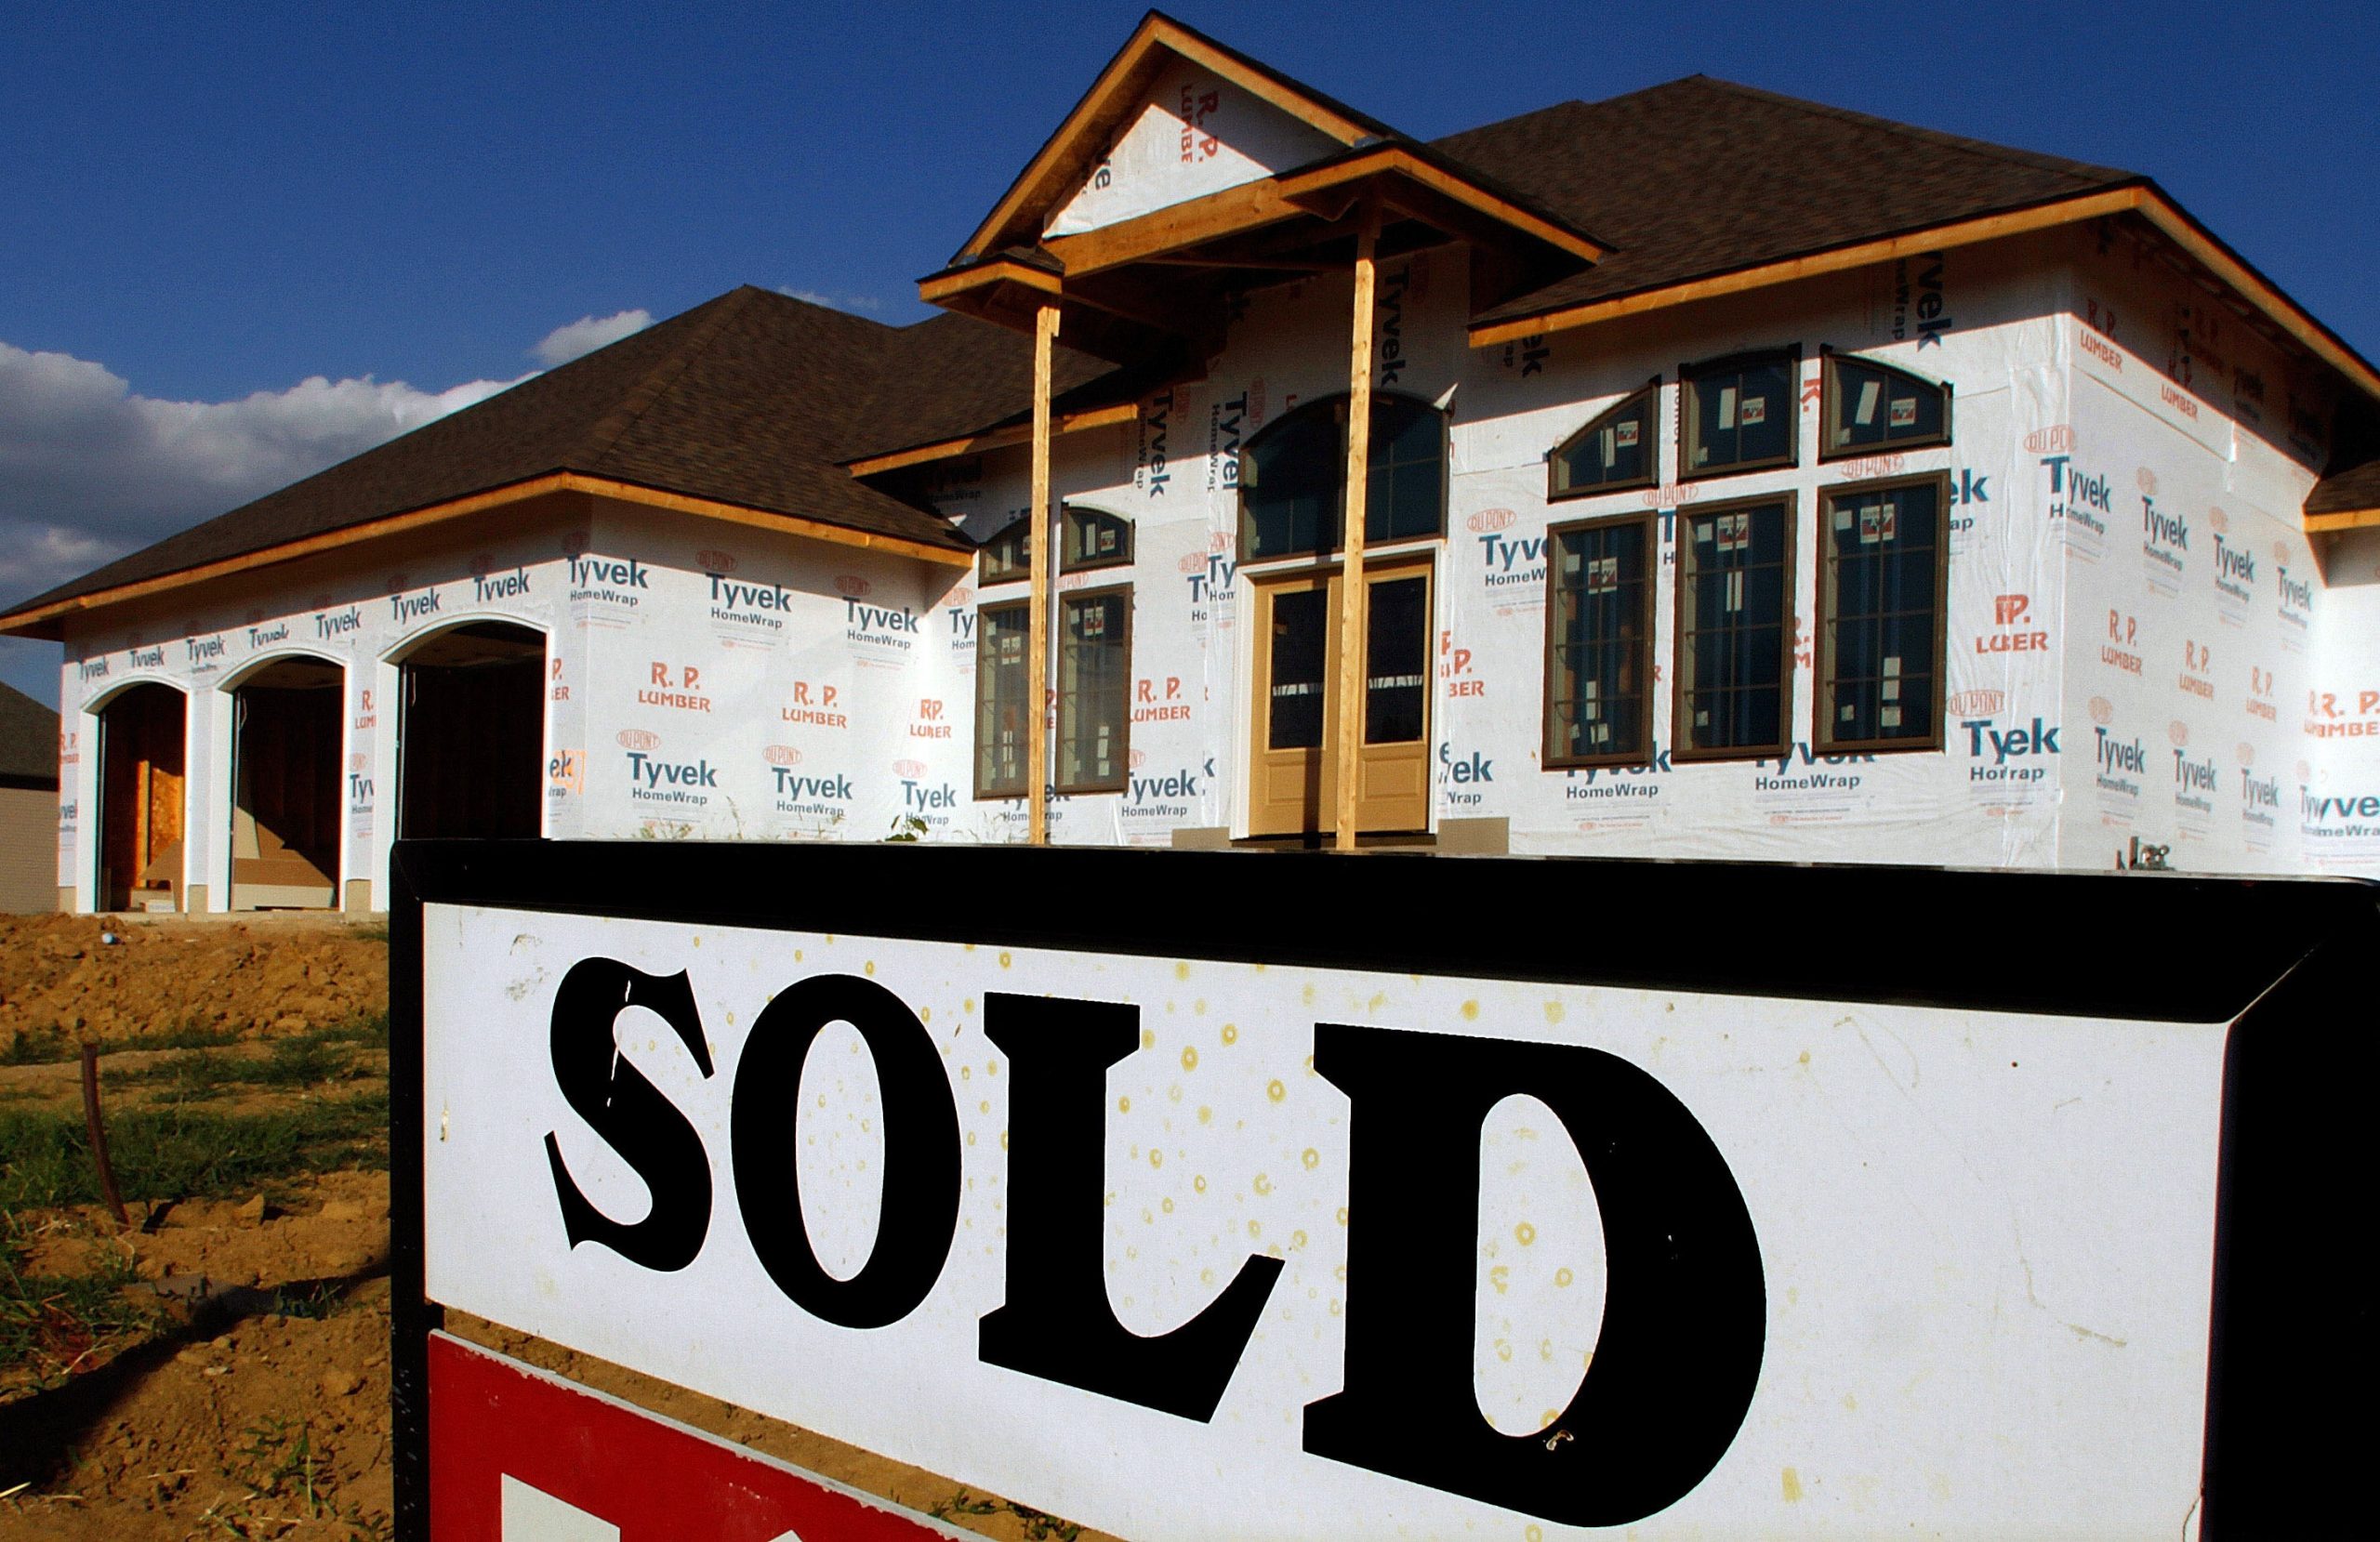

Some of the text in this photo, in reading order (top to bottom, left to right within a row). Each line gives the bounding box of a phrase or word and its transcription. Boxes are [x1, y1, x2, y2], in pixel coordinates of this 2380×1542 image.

[1917, 252, 1951, 352] vek
[1148, 389, 1173, 499] Tyvek
[2041, 455, 2110, 512] Tyvek
[2142, 495, 2187, 551] Tyvek
[1479, 534, 1547, 572] Tyv
[2214, 534, 2254, 583] Tyvek
[567, 556, 649, 589] Tyvek
[1485, 567, 1546, 586] HomeW
[570, 588, 639, 607] HomeWrap
[706, 573, 792, 613] Tyvek
[2278, 566, 2311, 613] Tyvek
[390, 587, 441, 625] Tyvek
[711, 606, 783, 630] HomeWrap
[842, 596, 919, 634] Tyvek
[316, 606, 361, 639] Tyvek
[186, 636, 226, 661] Tyvek
[847, 629, 911, 651] HomeWrap
[651, 662, 700, 691] R. P.
[2101, 646, 2142, 677] LUMBER
[639, 690, 710, 713] LUMBER
[794, 681, 838, 707] R. P.
[1138, 677, 1182, 703] R. P.
[2179, 673, 2214, 701] LUMBER
[782, 707, 847, 729] LUMBER
[2246, 699, 2277, 723] LUMBER
[2095, 726, 2146, 775] Tyvek
[627, 752, 717, 788] Tyvek
[772, 767, 853, 801] Tyvek
[1755, 773, 1860, 791] HomeWrap
[2173, 749, 2217, 793] Tyvek
[632, 787, 707, 806] HomeWrap
[1567, 784, 1659, 799] HomeWrap
[2241, 768, 2280, 809] Tyvek
[776, 799, 844, 818] HomeWrap
[1121, 804, 1187, 822] HomeWrap
[545, 956, 1768, 1529] SOLD
